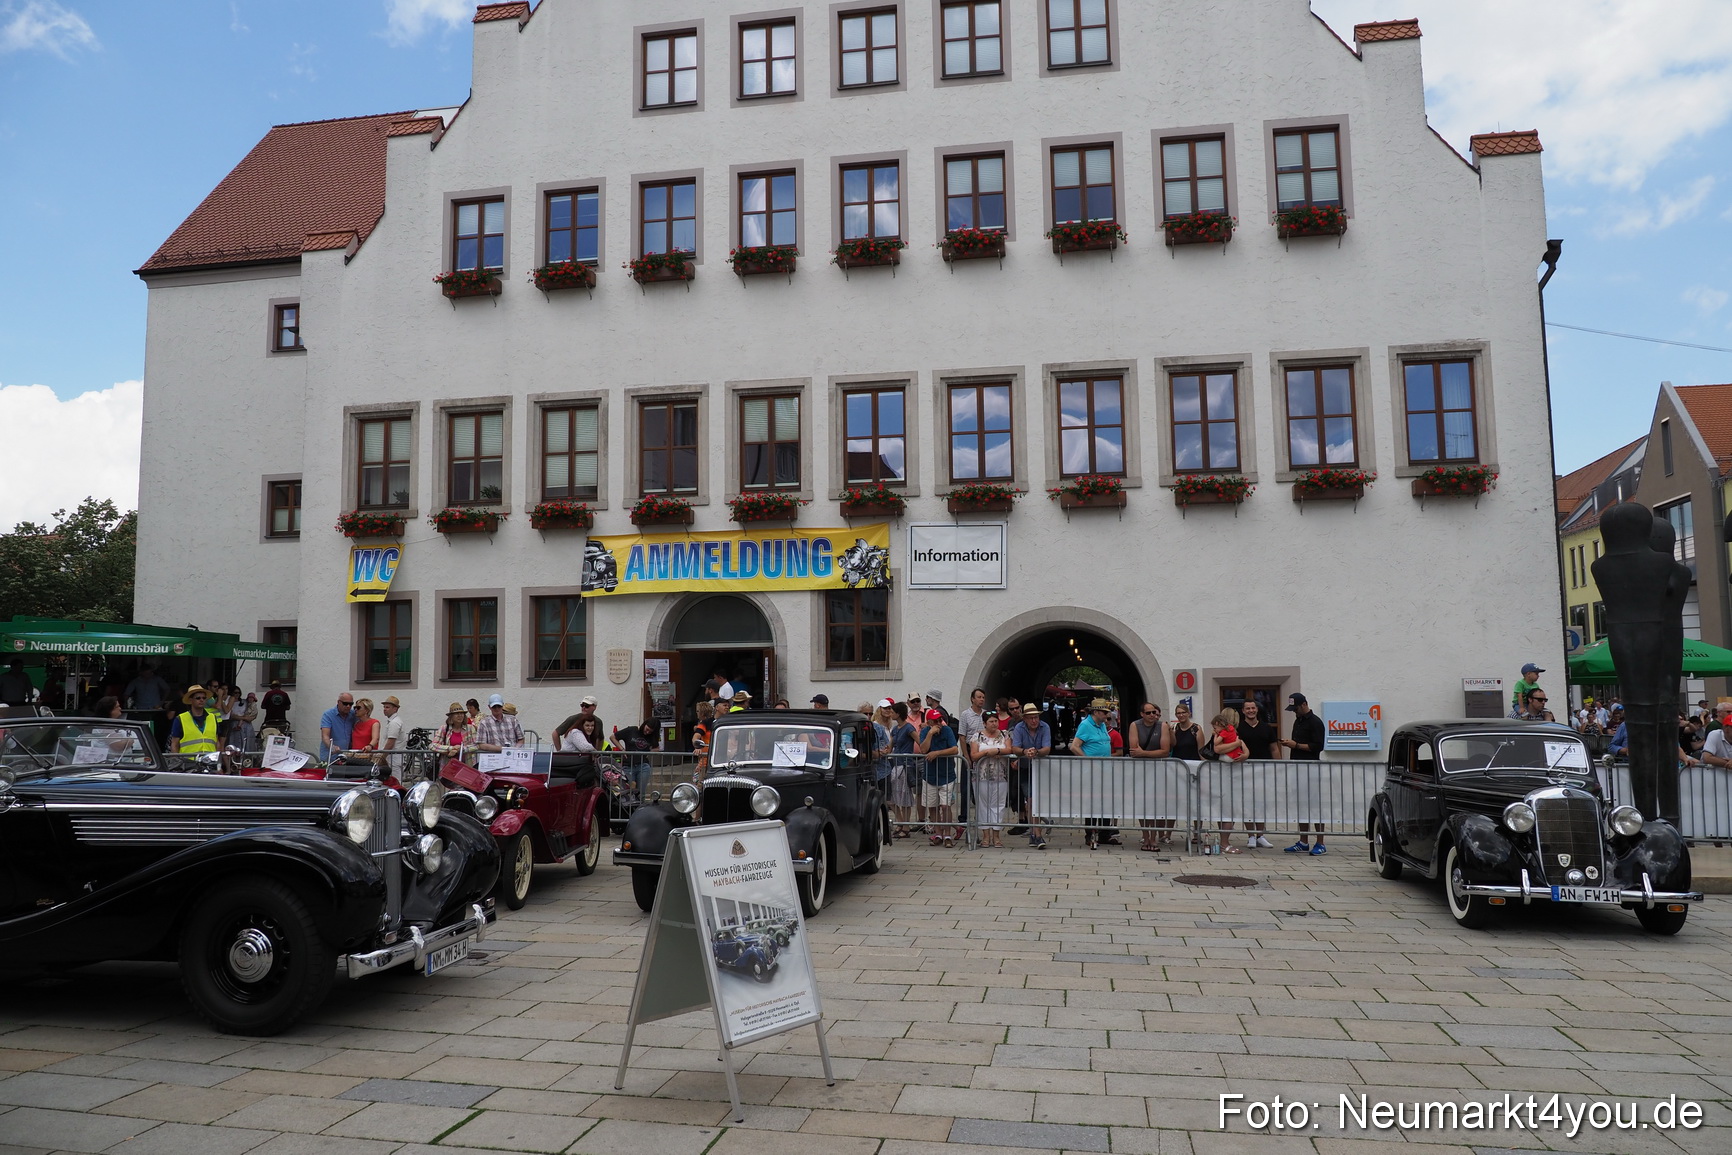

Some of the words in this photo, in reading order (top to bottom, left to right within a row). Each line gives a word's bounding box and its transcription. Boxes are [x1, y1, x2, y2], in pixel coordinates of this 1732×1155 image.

[623, 537, 833, 582] ANMELDUNG
[914, 548, 999, 562] Information
[352, 547, 400, 583] WC
[30, 641, 99, 652] Neumarkter
[101, 642, 169, 654] Lammsbräu
[233, 648, 266, 659] Neumarkter
[1328, 720, 1367, 731] Kunst
[292, 755, 303, 763] 167
[704, 867, 729, 878] MUSEUM
[730, 863, 741, 874] FÜR
[742, 860, 778, 873] HISTORISCHE
[713, 870, 774, 888] MAYBACH-FAHRZEUGE
[1560, 888, 1576, 900] AN
